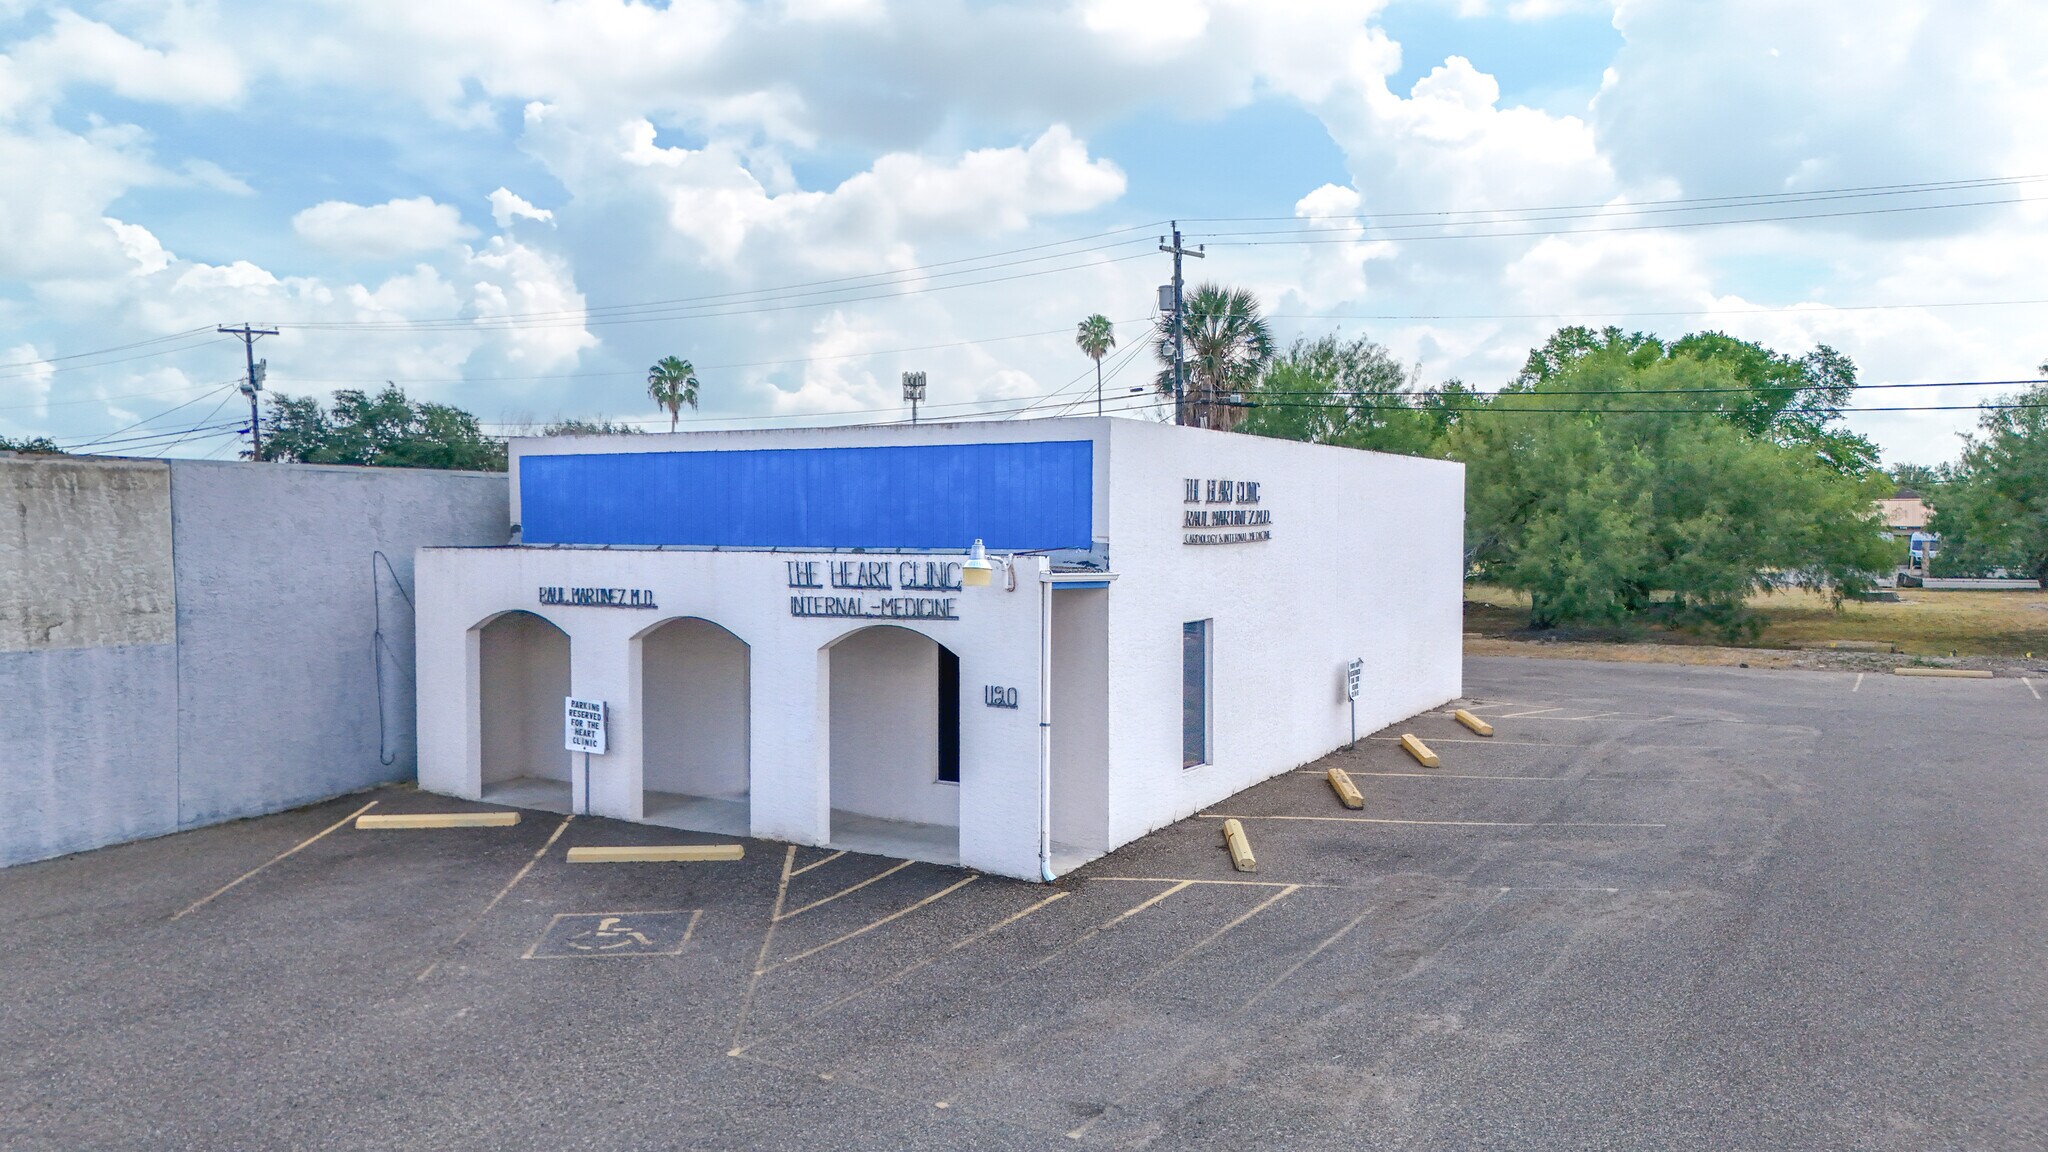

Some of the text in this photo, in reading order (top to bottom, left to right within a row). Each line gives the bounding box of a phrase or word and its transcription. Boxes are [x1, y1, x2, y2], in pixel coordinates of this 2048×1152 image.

[785, 560, 962, 589] THE HEART CLINIC
[985, 684, 1018, 707] 1120
[571, 700, 600, 712] PARKING
[569, 708, 601, 721] RESERVED
[570, 718, 600, 730] FOR THE
[574, 728, 596, 738] HEART
[572, 736, 597, 748] CLINIC
